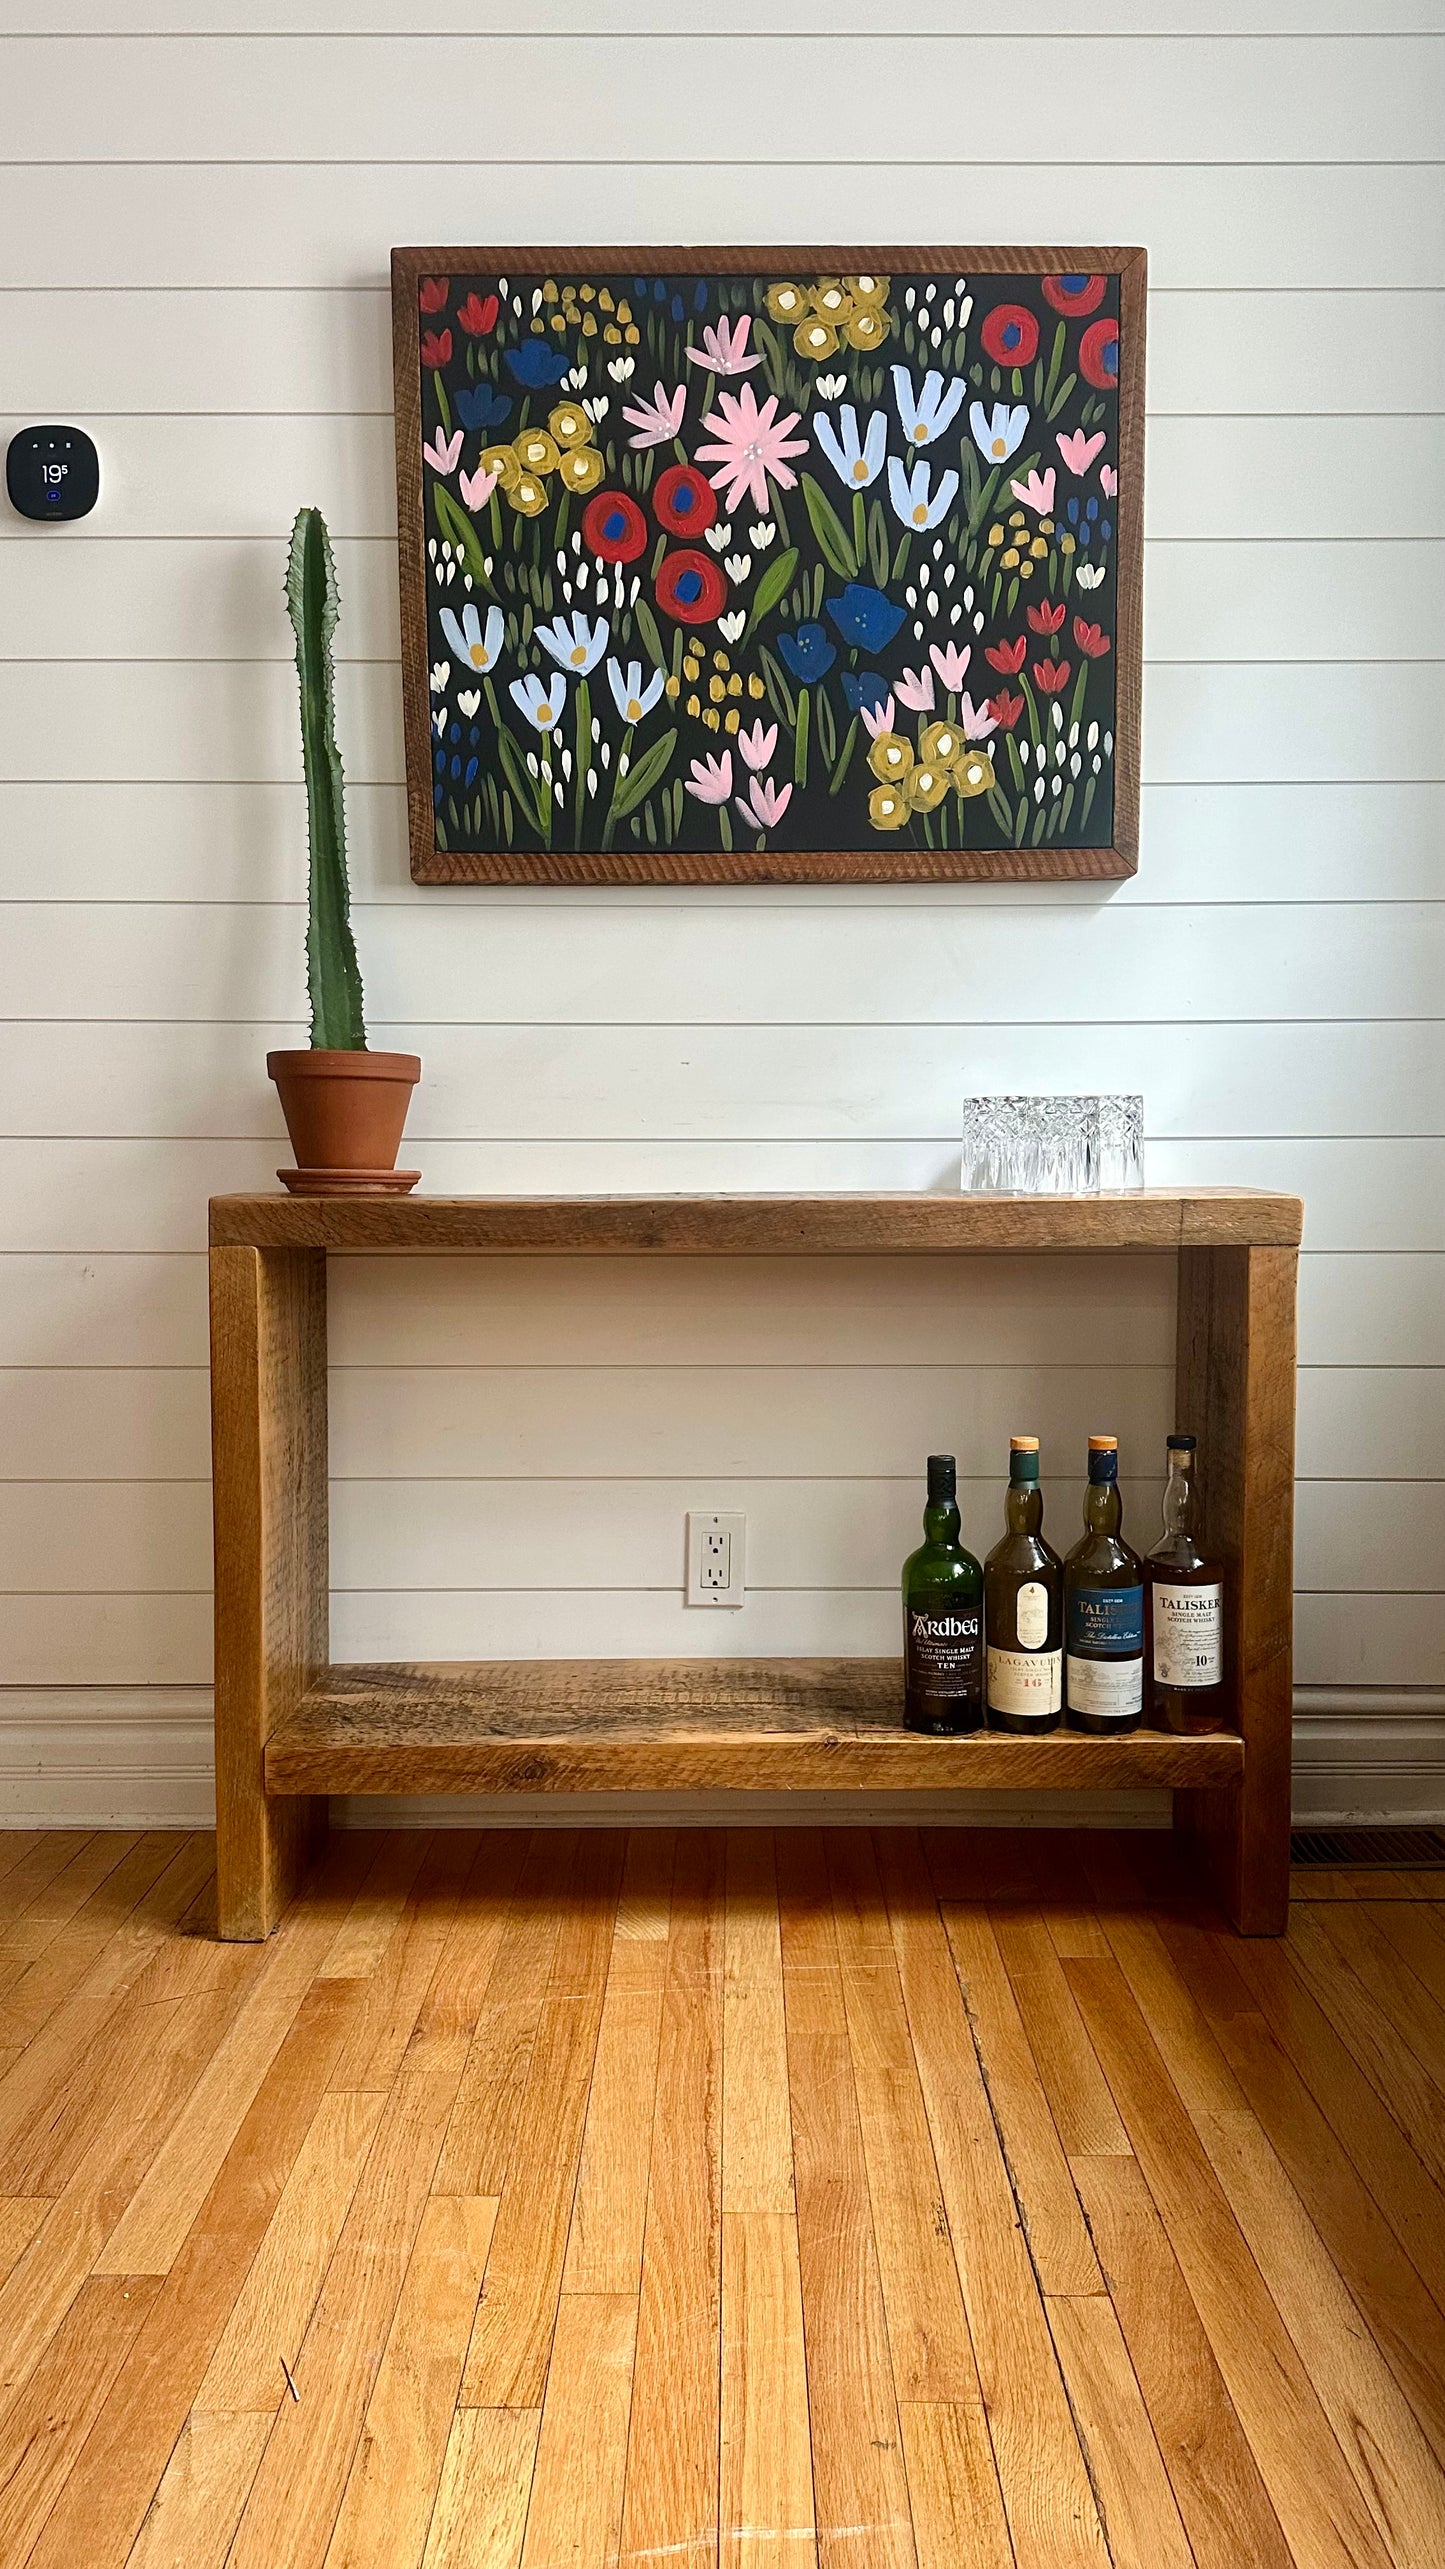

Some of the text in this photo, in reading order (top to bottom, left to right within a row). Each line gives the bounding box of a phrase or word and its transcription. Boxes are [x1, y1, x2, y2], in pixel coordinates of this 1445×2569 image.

[1160, 1596, 1221, 1611] TALISKER
[934, 1647, 959, 1655] SINGLE
[960, 1646, 974, 1654] MALT
[1196, 1655, 1207, 1667] 10
[1023, 1678, 1042, 1688] 16
